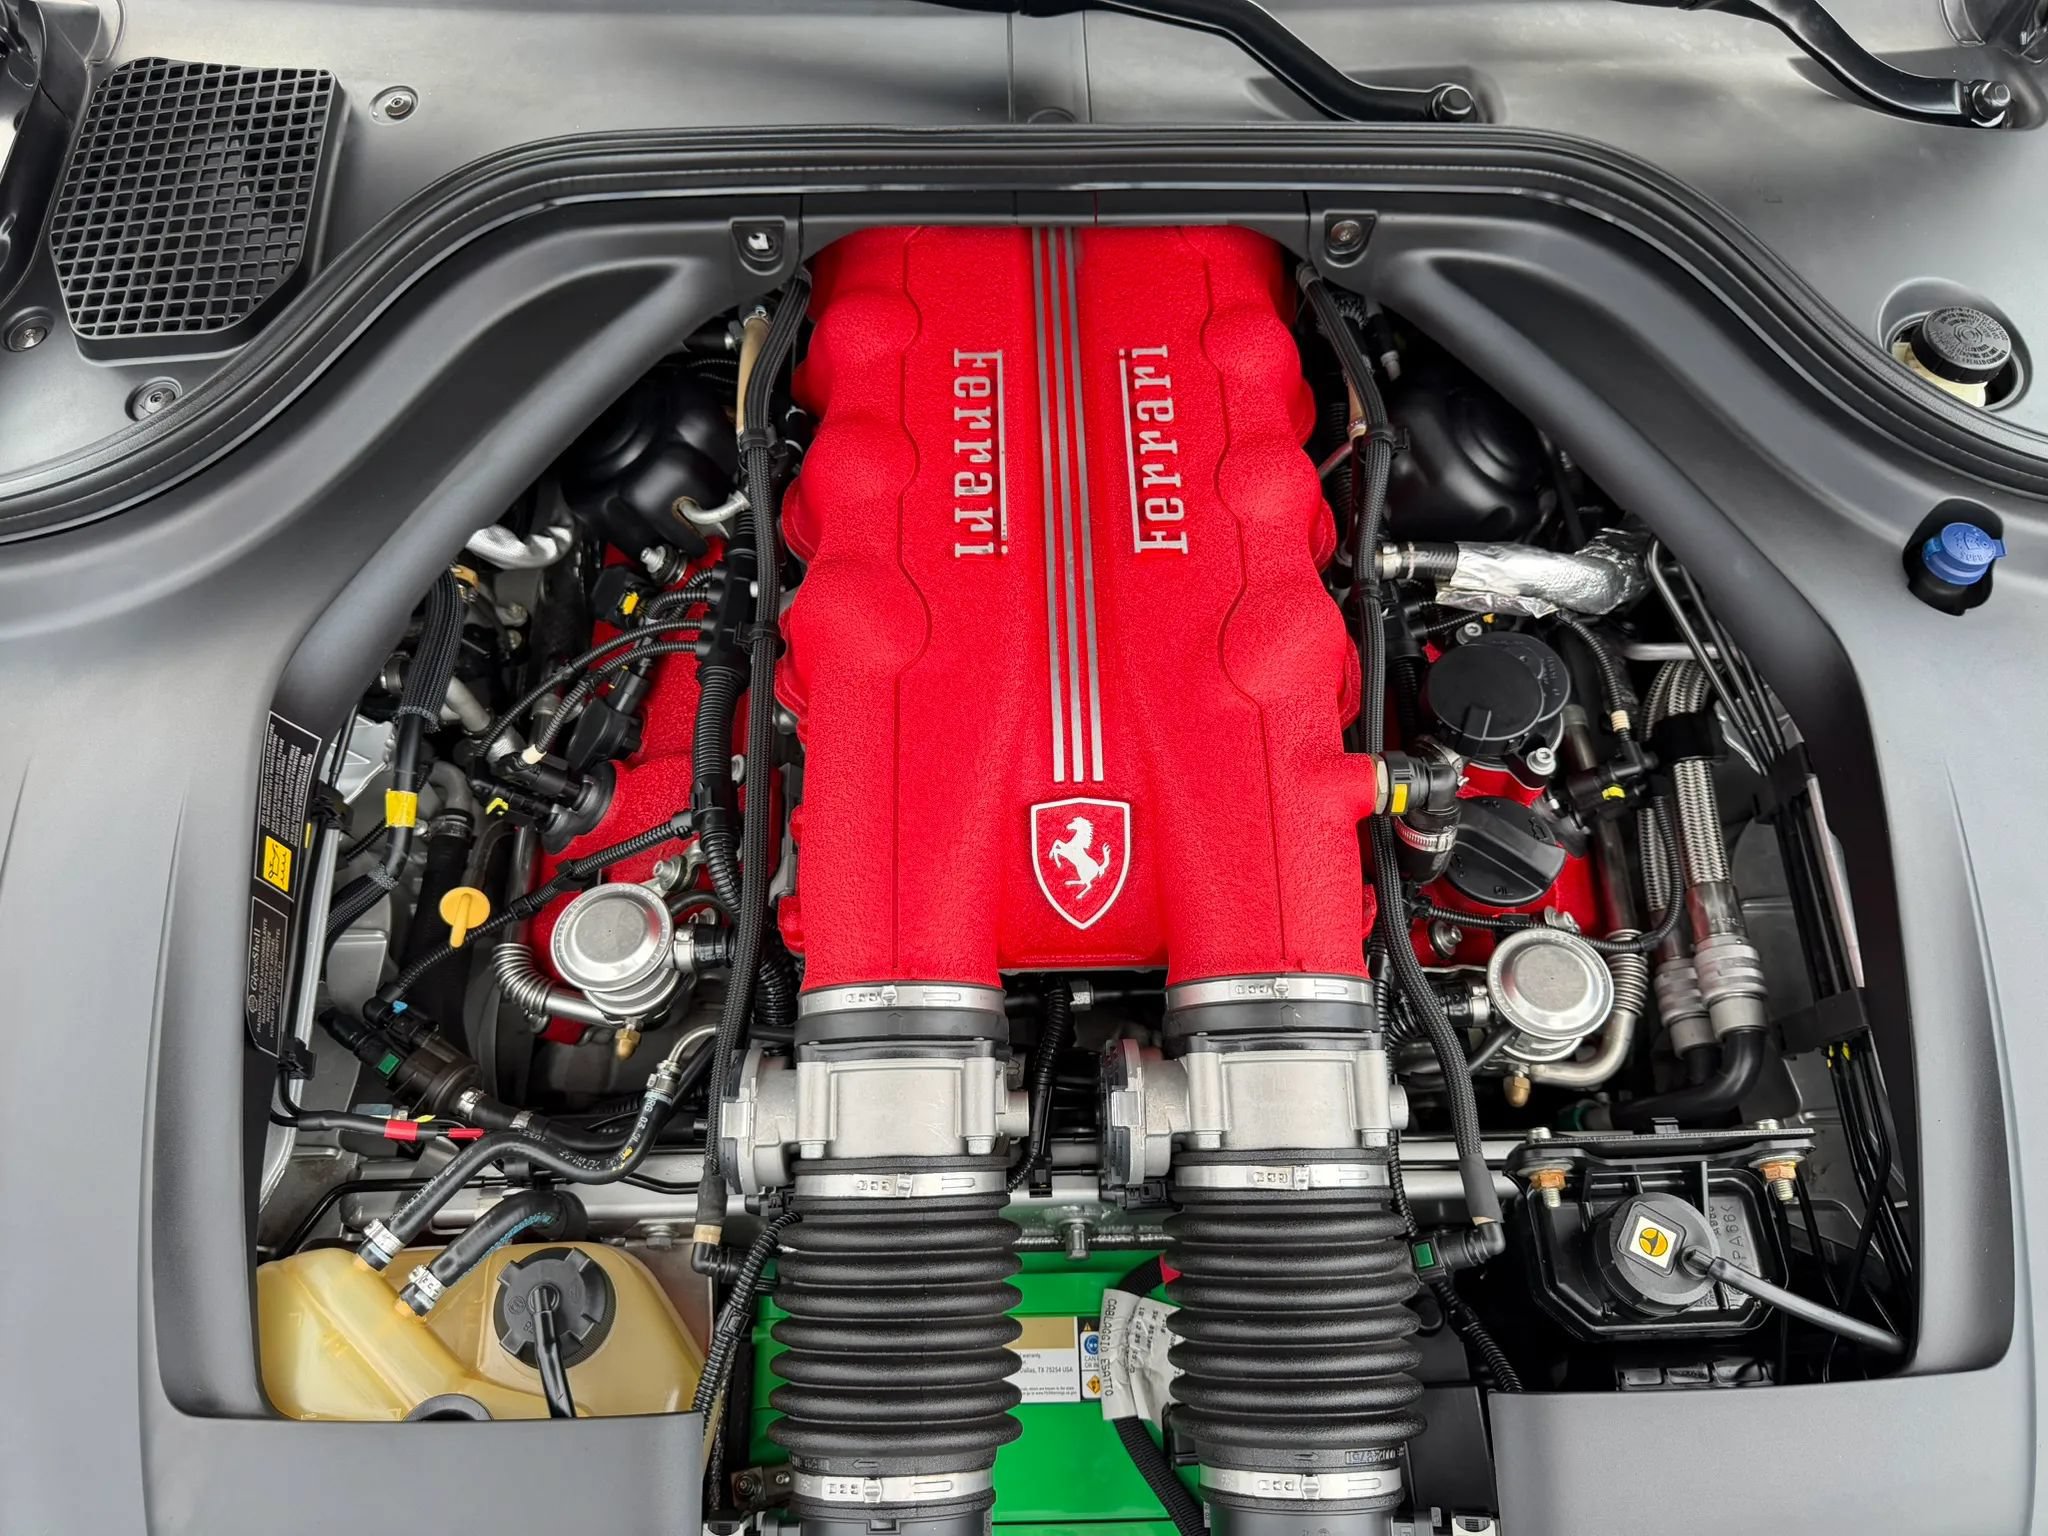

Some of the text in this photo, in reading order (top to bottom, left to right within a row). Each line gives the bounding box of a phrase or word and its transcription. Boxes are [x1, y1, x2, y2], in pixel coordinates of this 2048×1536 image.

[953, 348, 1009, 559] Ferrari
[1118, 344, 1188, 554] Ferrari
[250, 928, 261, 991] GlycoShell
[1100, 1298, 1117, 1397] CABLAGGIO ESATTO
